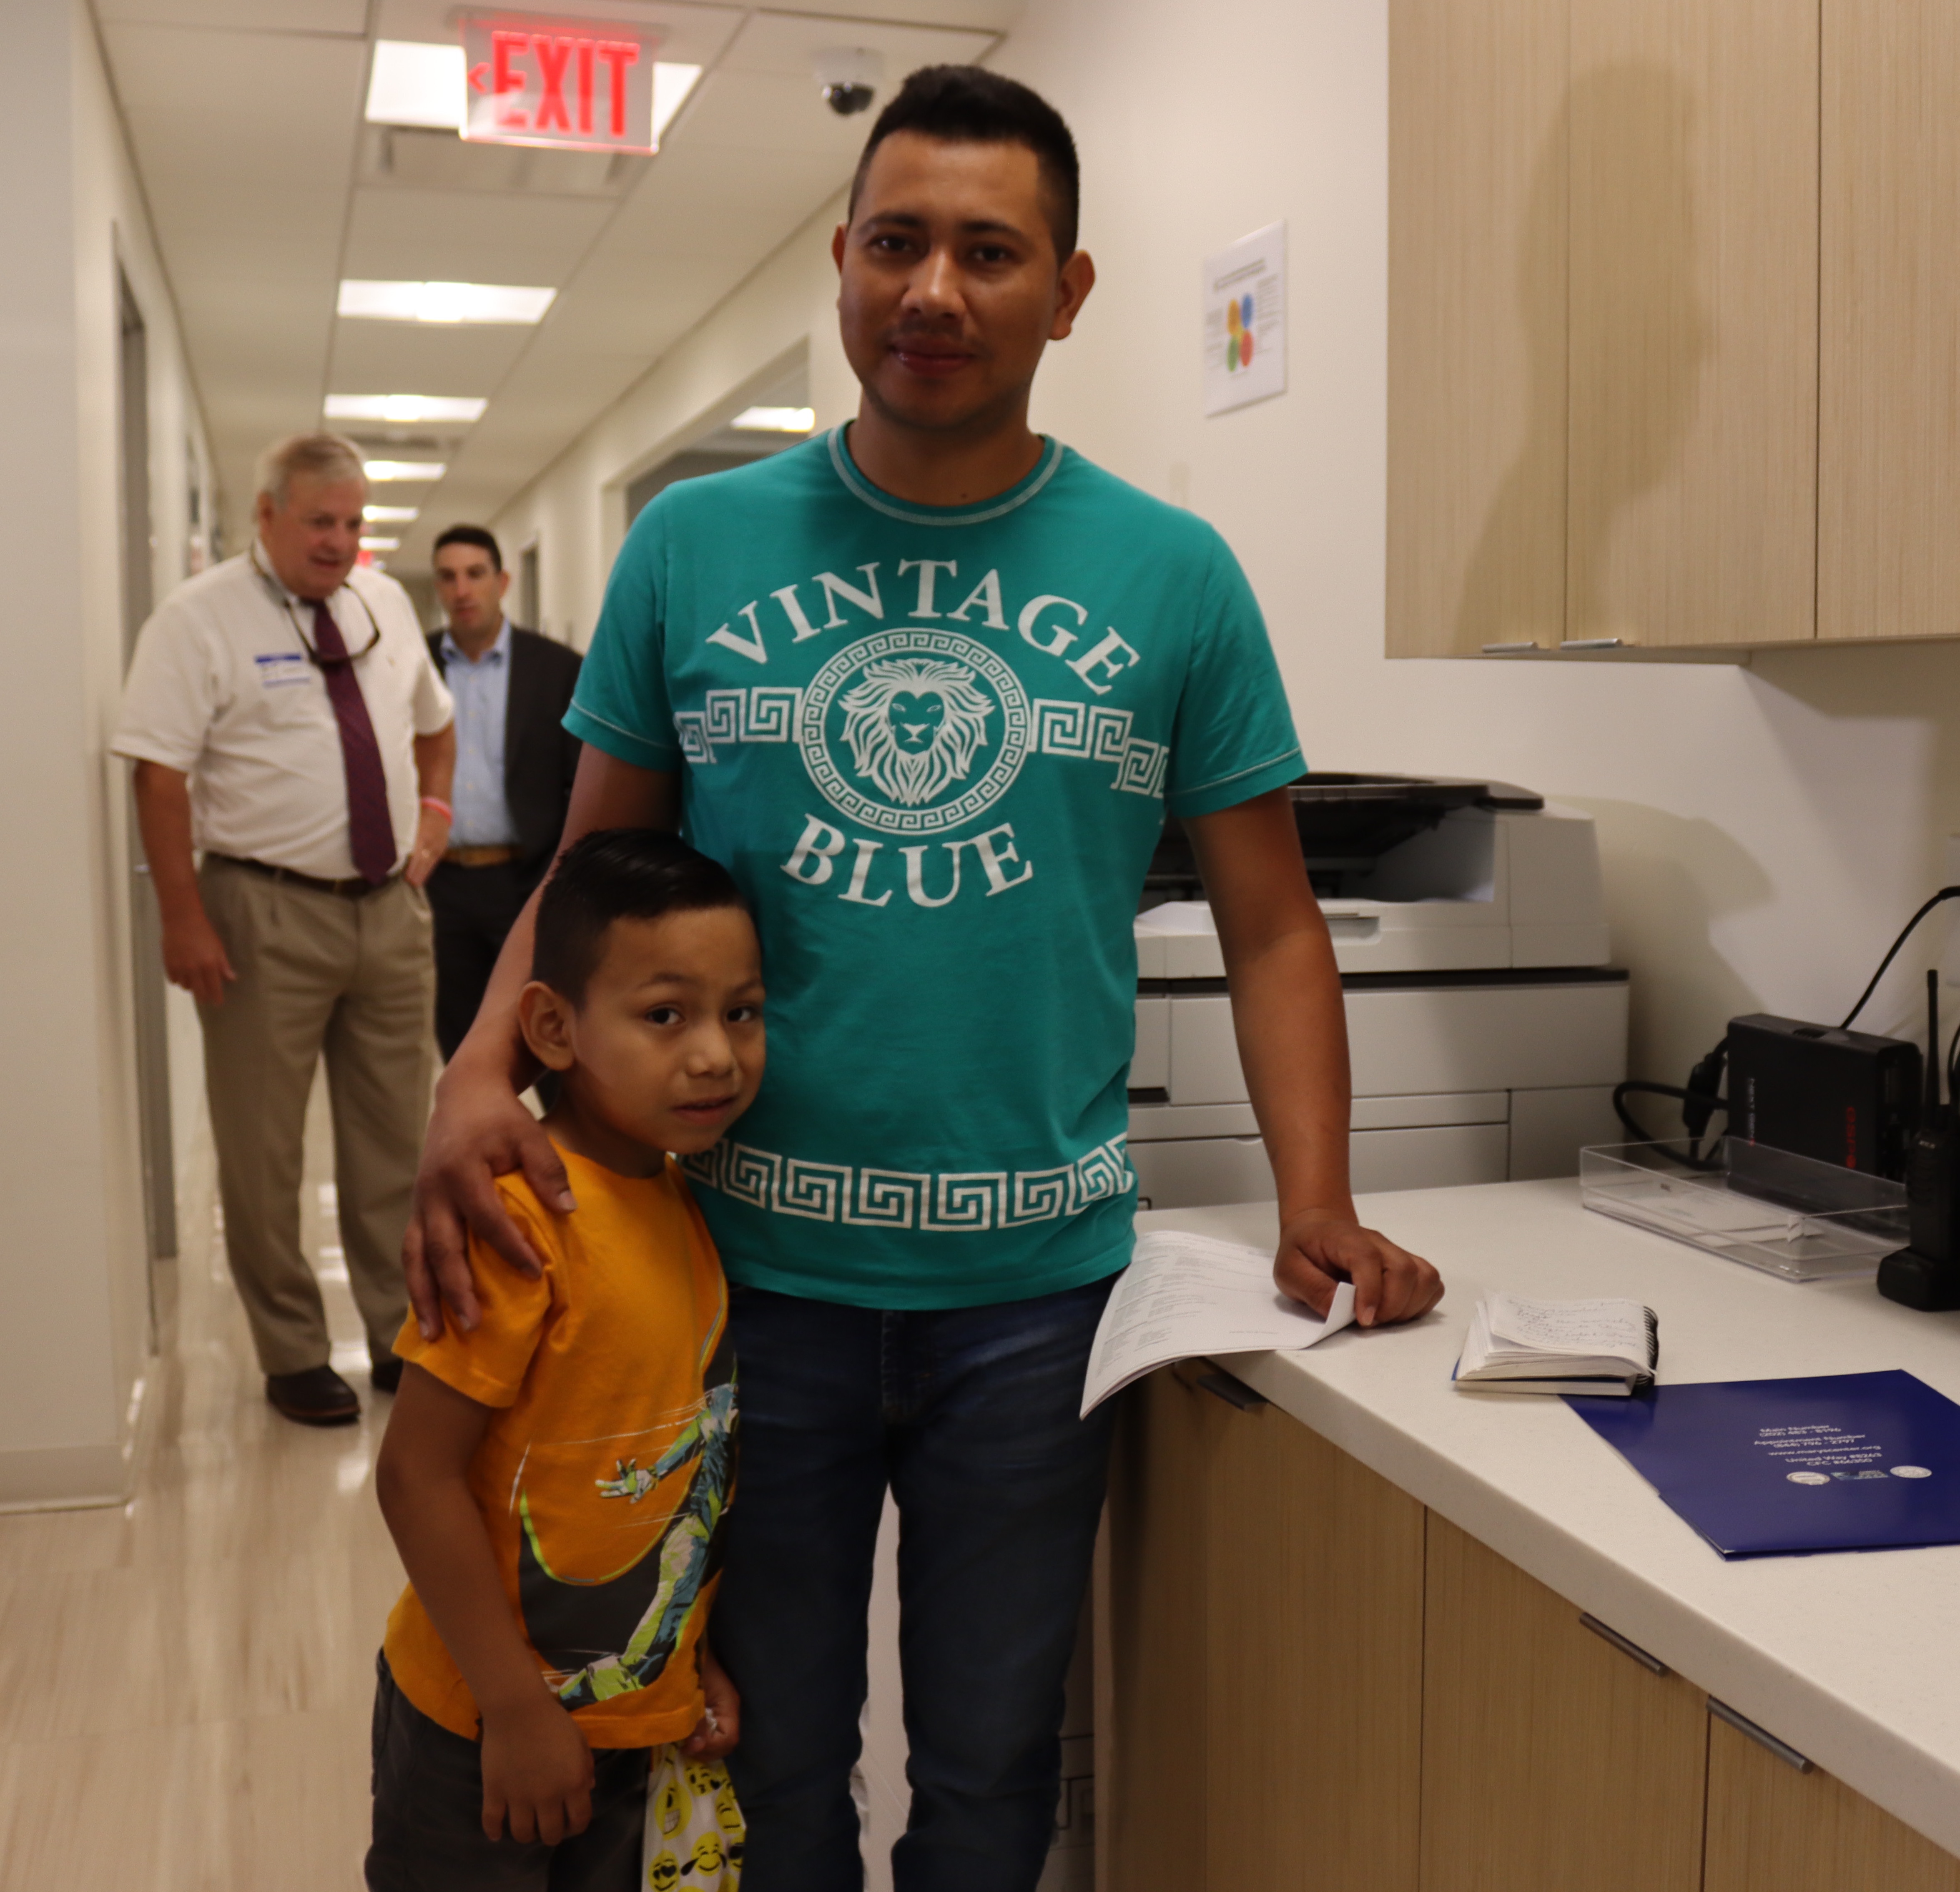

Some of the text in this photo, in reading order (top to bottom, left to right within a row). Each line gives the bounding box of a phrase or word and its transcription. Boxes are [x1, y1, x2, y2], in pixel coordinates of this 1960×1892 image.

[492, 30, 640, 137] EXIT
[706, 559, 1141, 695] VINTAGE
[780, 813, 1033, 907] BLUE
